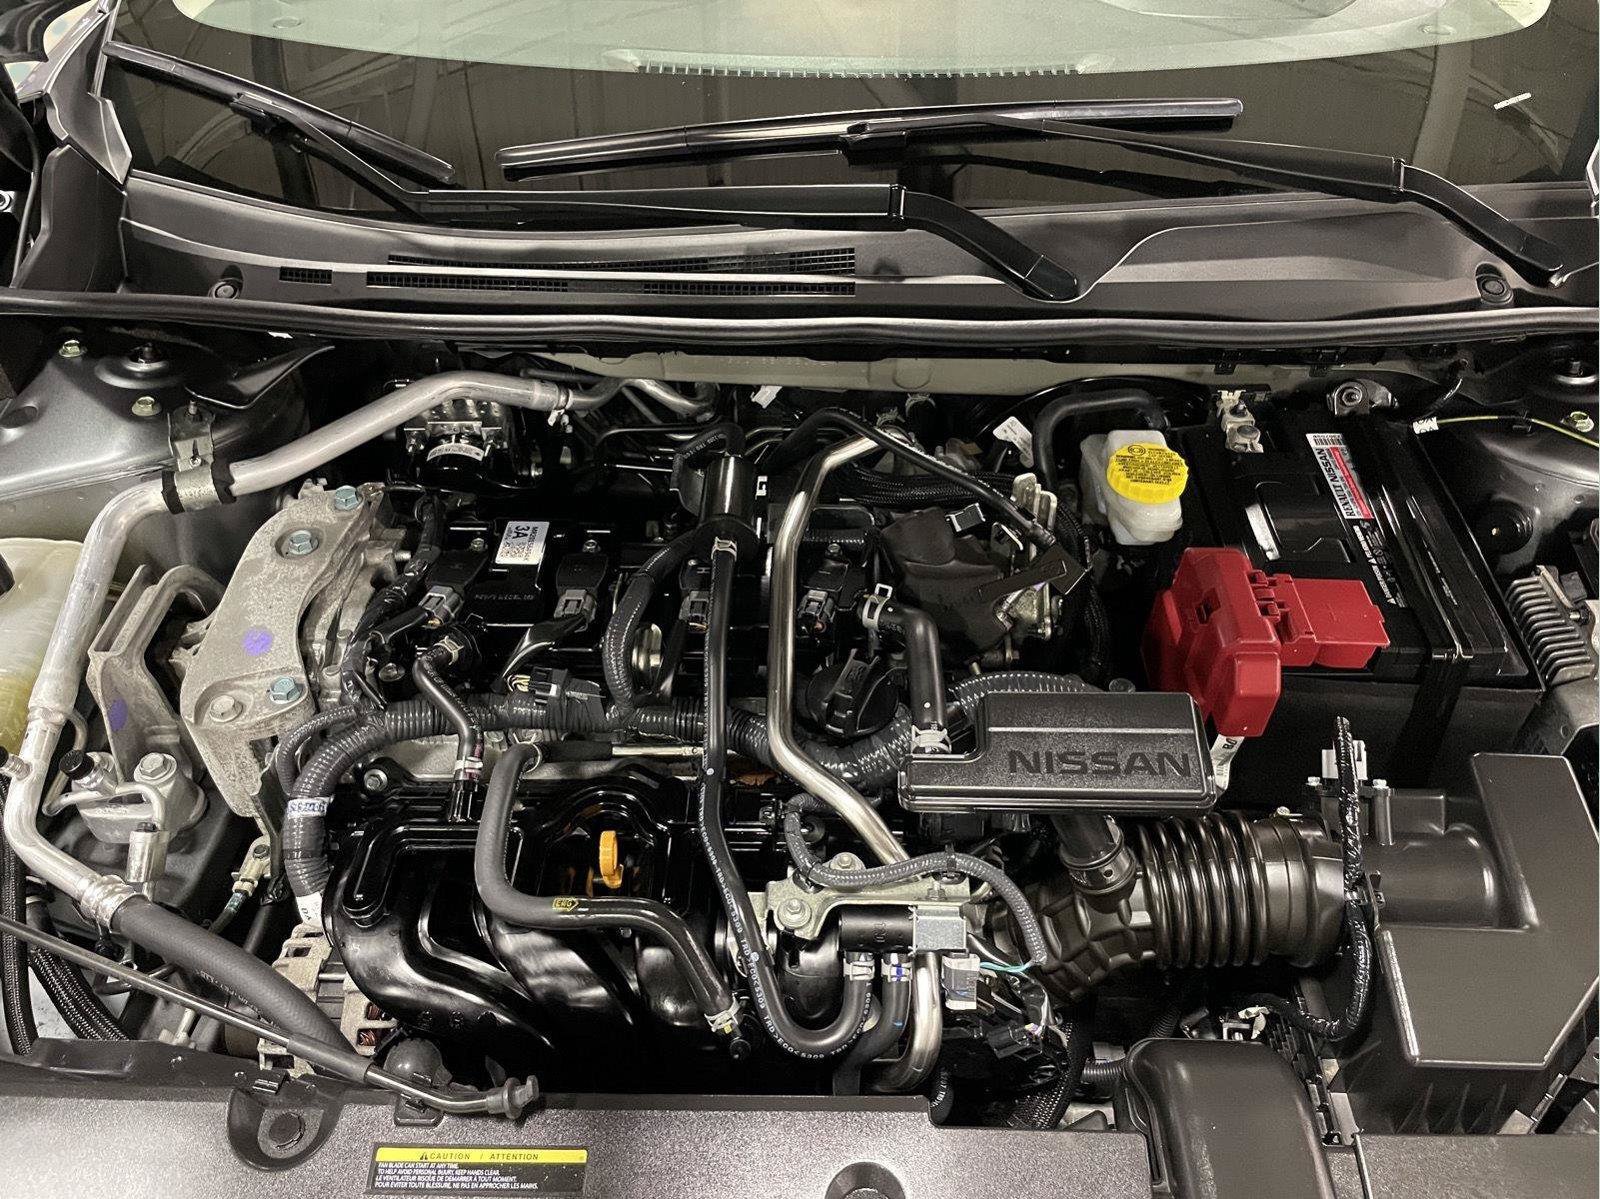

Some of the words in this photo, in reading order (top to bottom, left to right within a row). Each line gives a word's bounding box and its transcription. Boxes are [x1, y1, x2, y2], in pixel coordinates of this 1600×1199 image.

[1314, 448, 1339, 482] NISSAN
[511, 525, 531, 540] 3A
[1007, 750, 1192, 778] NISSAN
